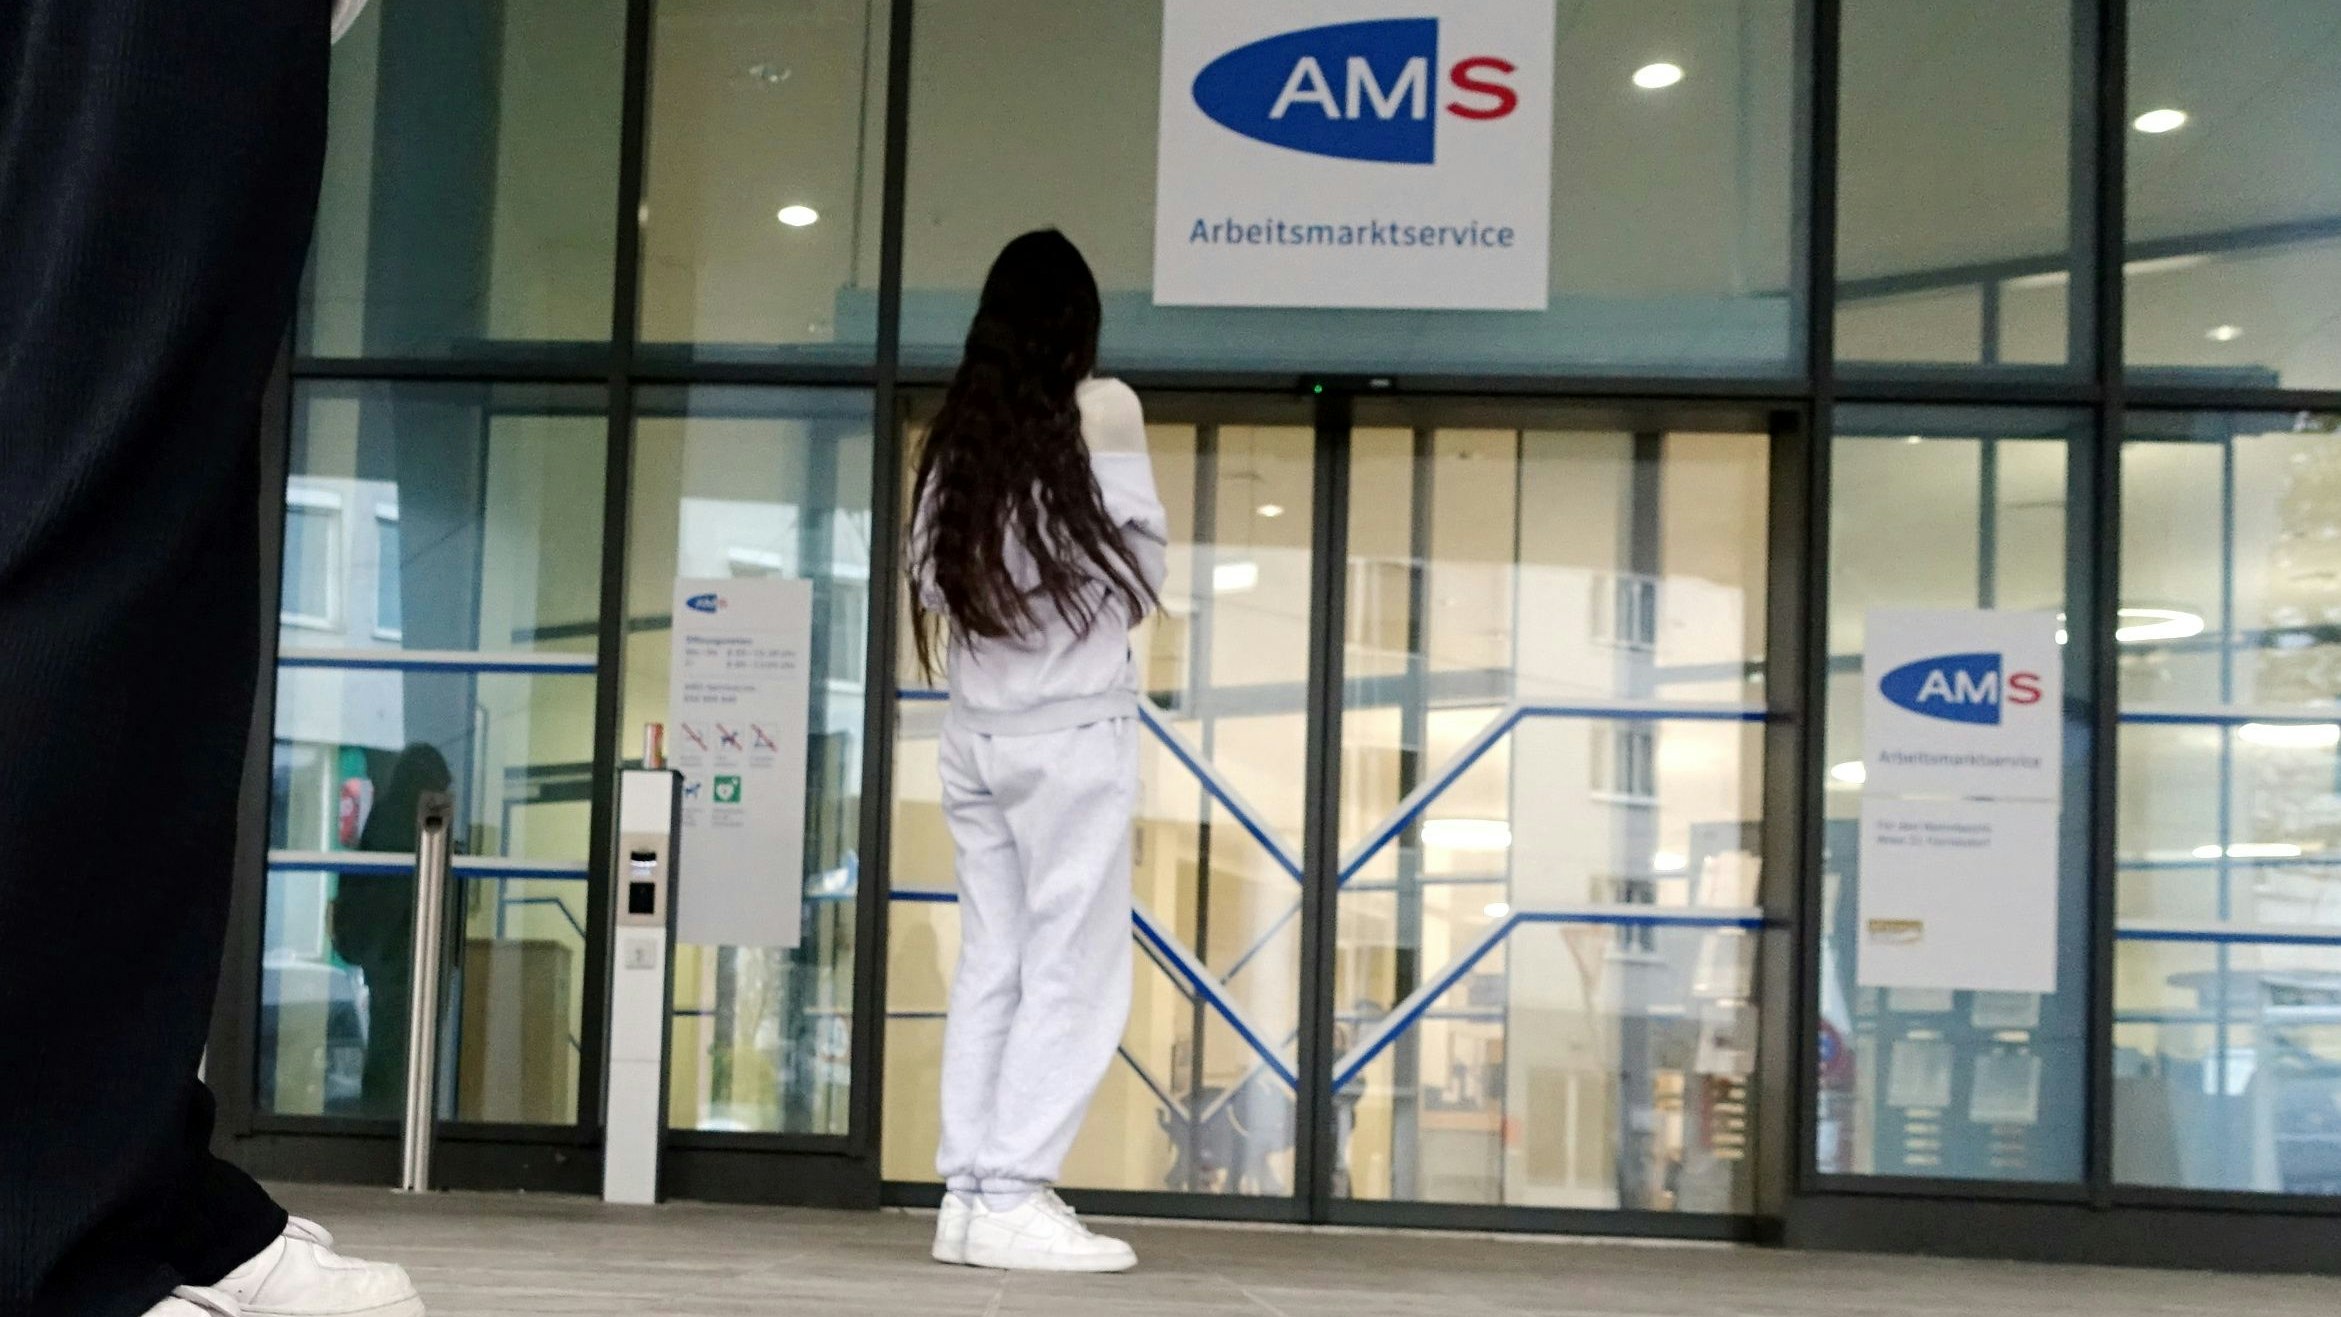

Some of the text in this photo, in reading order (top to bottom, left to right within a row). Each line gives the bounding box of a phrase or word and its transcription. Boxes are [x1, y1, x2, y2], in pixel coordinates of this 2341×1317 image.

[1267, 55, 1519, 121] AMS
[1188, 217, 1516, 248] Arbeitsmarktservice
[1917, 669, 2042, 704] AMS
